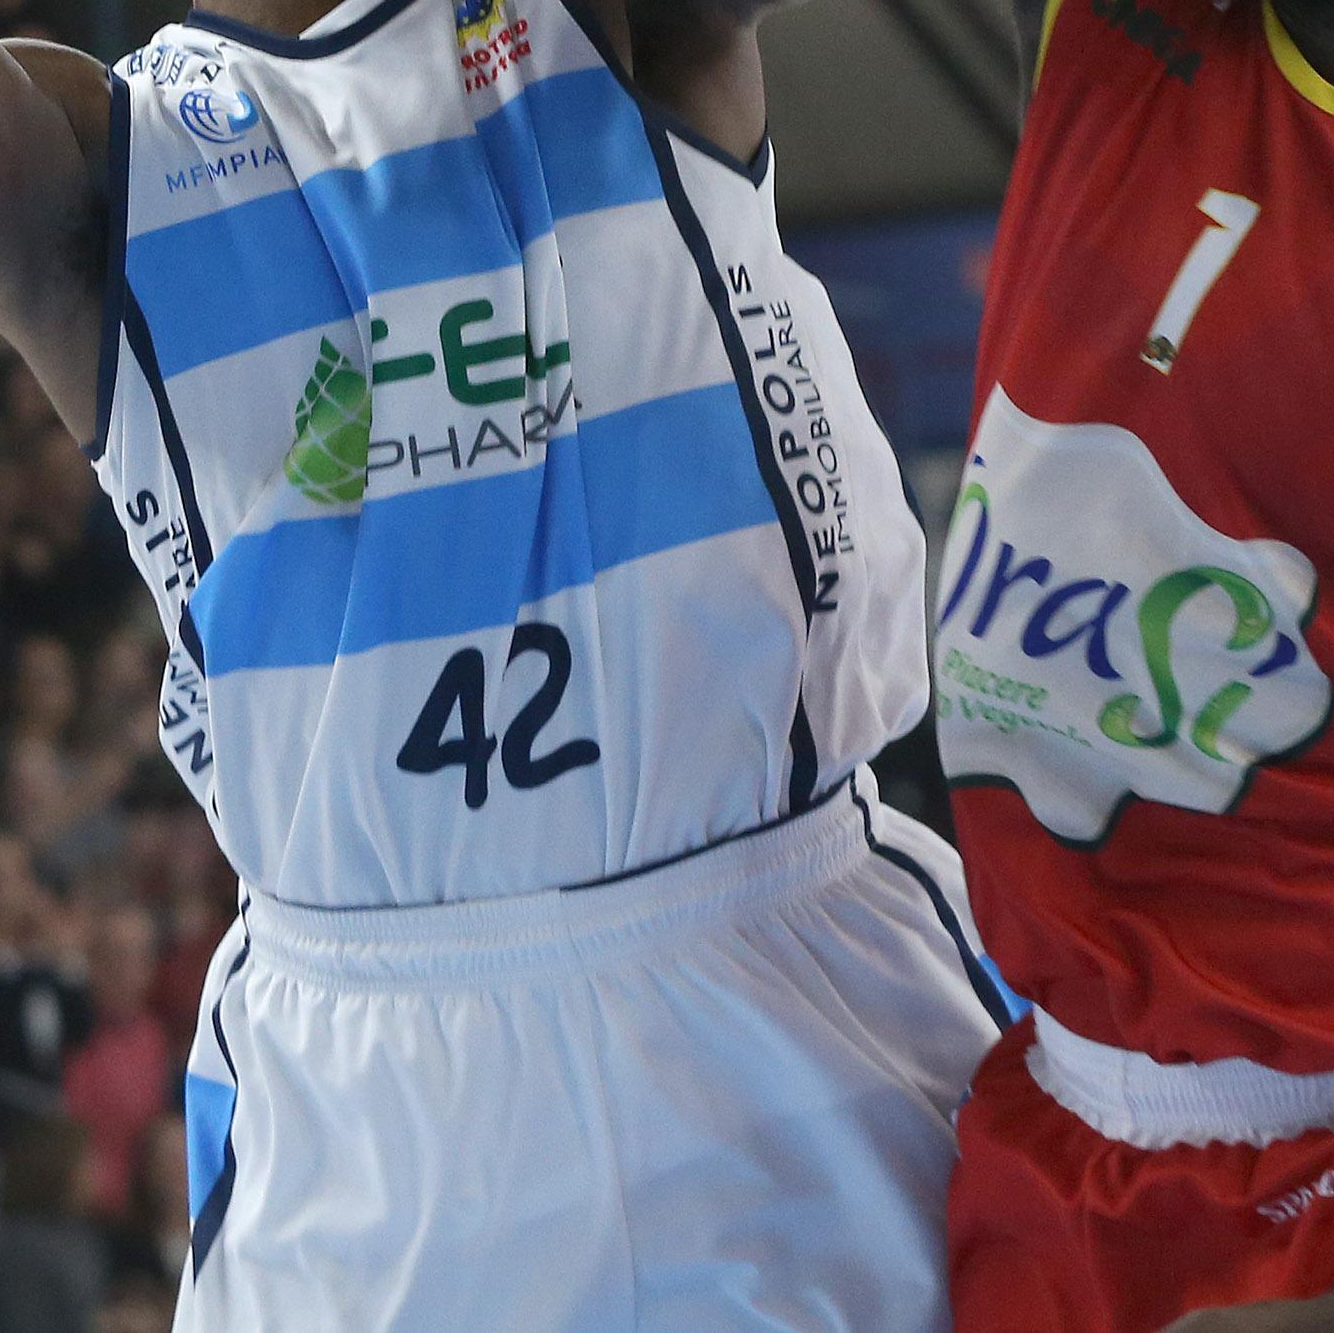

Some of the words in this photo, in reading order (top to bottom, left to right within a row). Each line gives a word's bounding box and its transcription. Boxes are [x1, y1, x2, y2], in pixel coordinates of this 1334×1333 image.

[1139, 187, 1262, 376] 1
[728, 263, 839, 613] NEOPOLIS
[770, 298, 854, 553] IMMOBILIARE
[396, 622, 601, 809] 42
